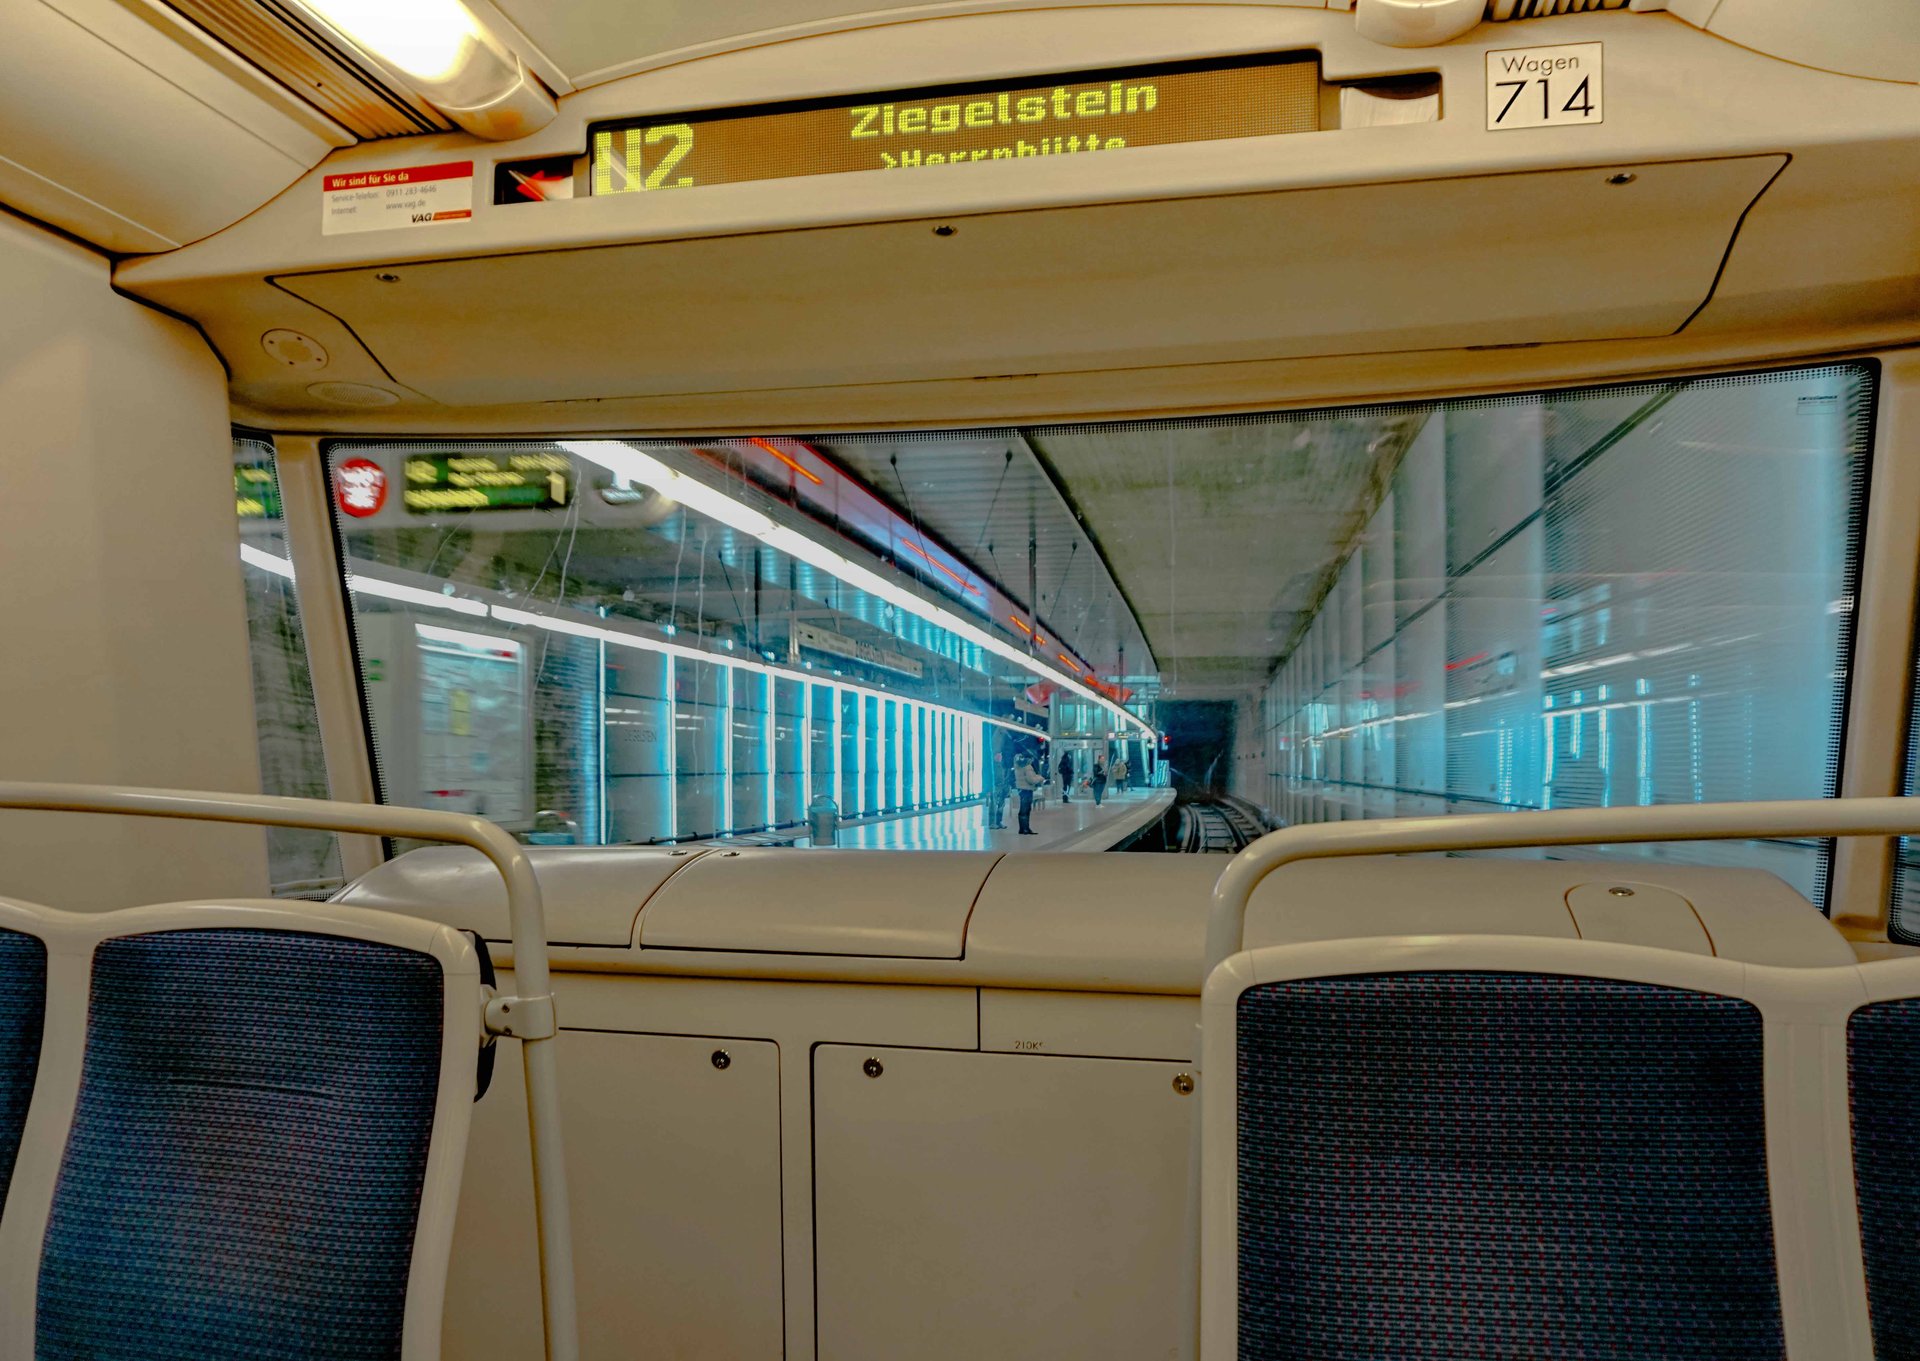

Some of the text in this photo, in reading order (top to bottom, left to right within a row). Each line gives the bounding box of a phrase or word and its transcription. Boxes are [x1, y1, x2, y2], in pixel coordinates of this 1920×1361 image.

[1501, 55, 1579, 76] Wagen
[1495, 74, 1595, 123] 714
[851, 82, 1157, 138] Ziegelstein
[332, 171, 409, 188] Wir sind für Sie da
[411, 212, 432, 223] VAG
